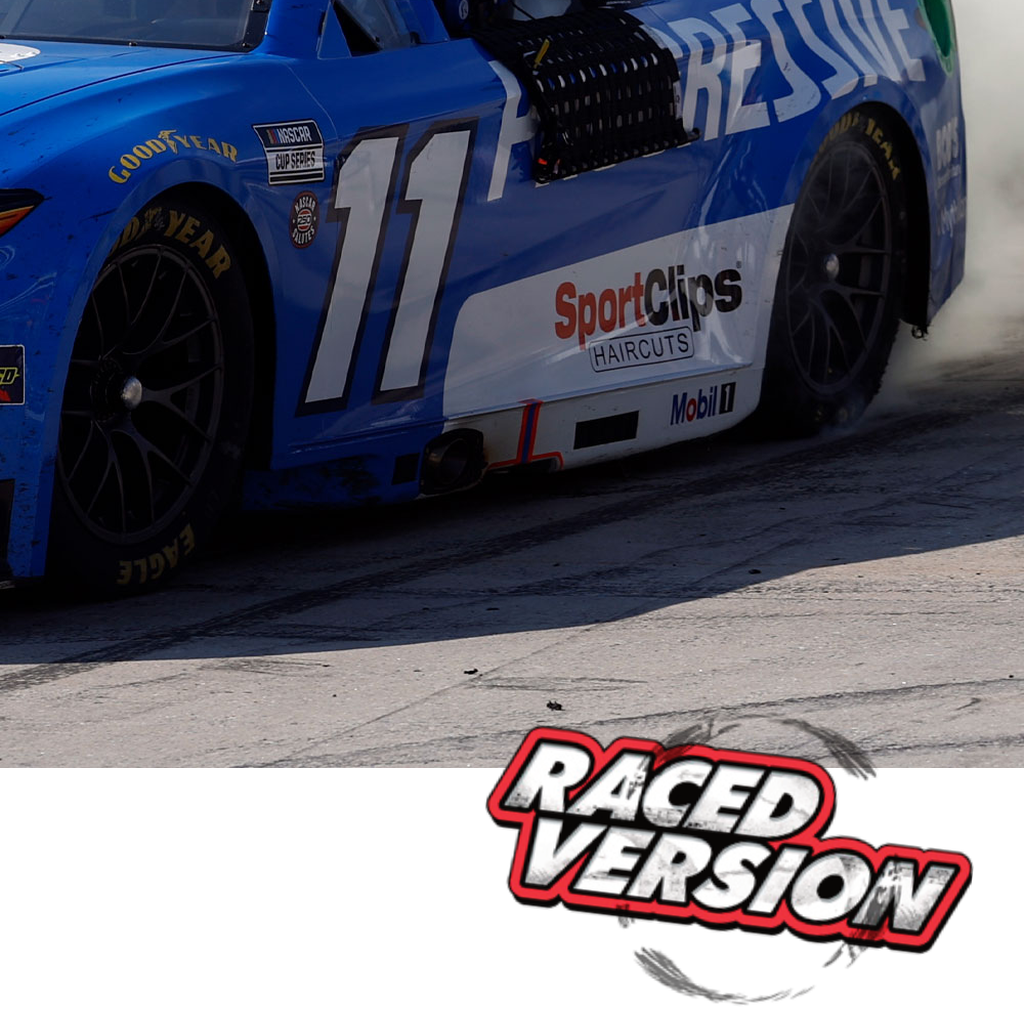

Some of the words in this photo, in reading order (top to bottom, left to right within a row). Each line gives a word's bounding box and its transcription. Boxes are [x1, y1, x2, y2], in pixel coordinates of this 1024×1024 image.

[276, 125, 313, 145] NASCAR
[108, 129, 238, 185] GOODYEAR
[275, 151, 290, 170] CUP
[291, 149, 316, 169] SERIES
[294, 195, 317, 215] NASCAR
[292, 225, 315, 245] SALUTES
[302, 128, 473, 406] 11
[593, 332, 690, 367] HAIRCUTS
[670, 385, 718, 426] Mobil
[719, 382, 736, 414] 1
[116, 522, 195, 585] EAGLE
